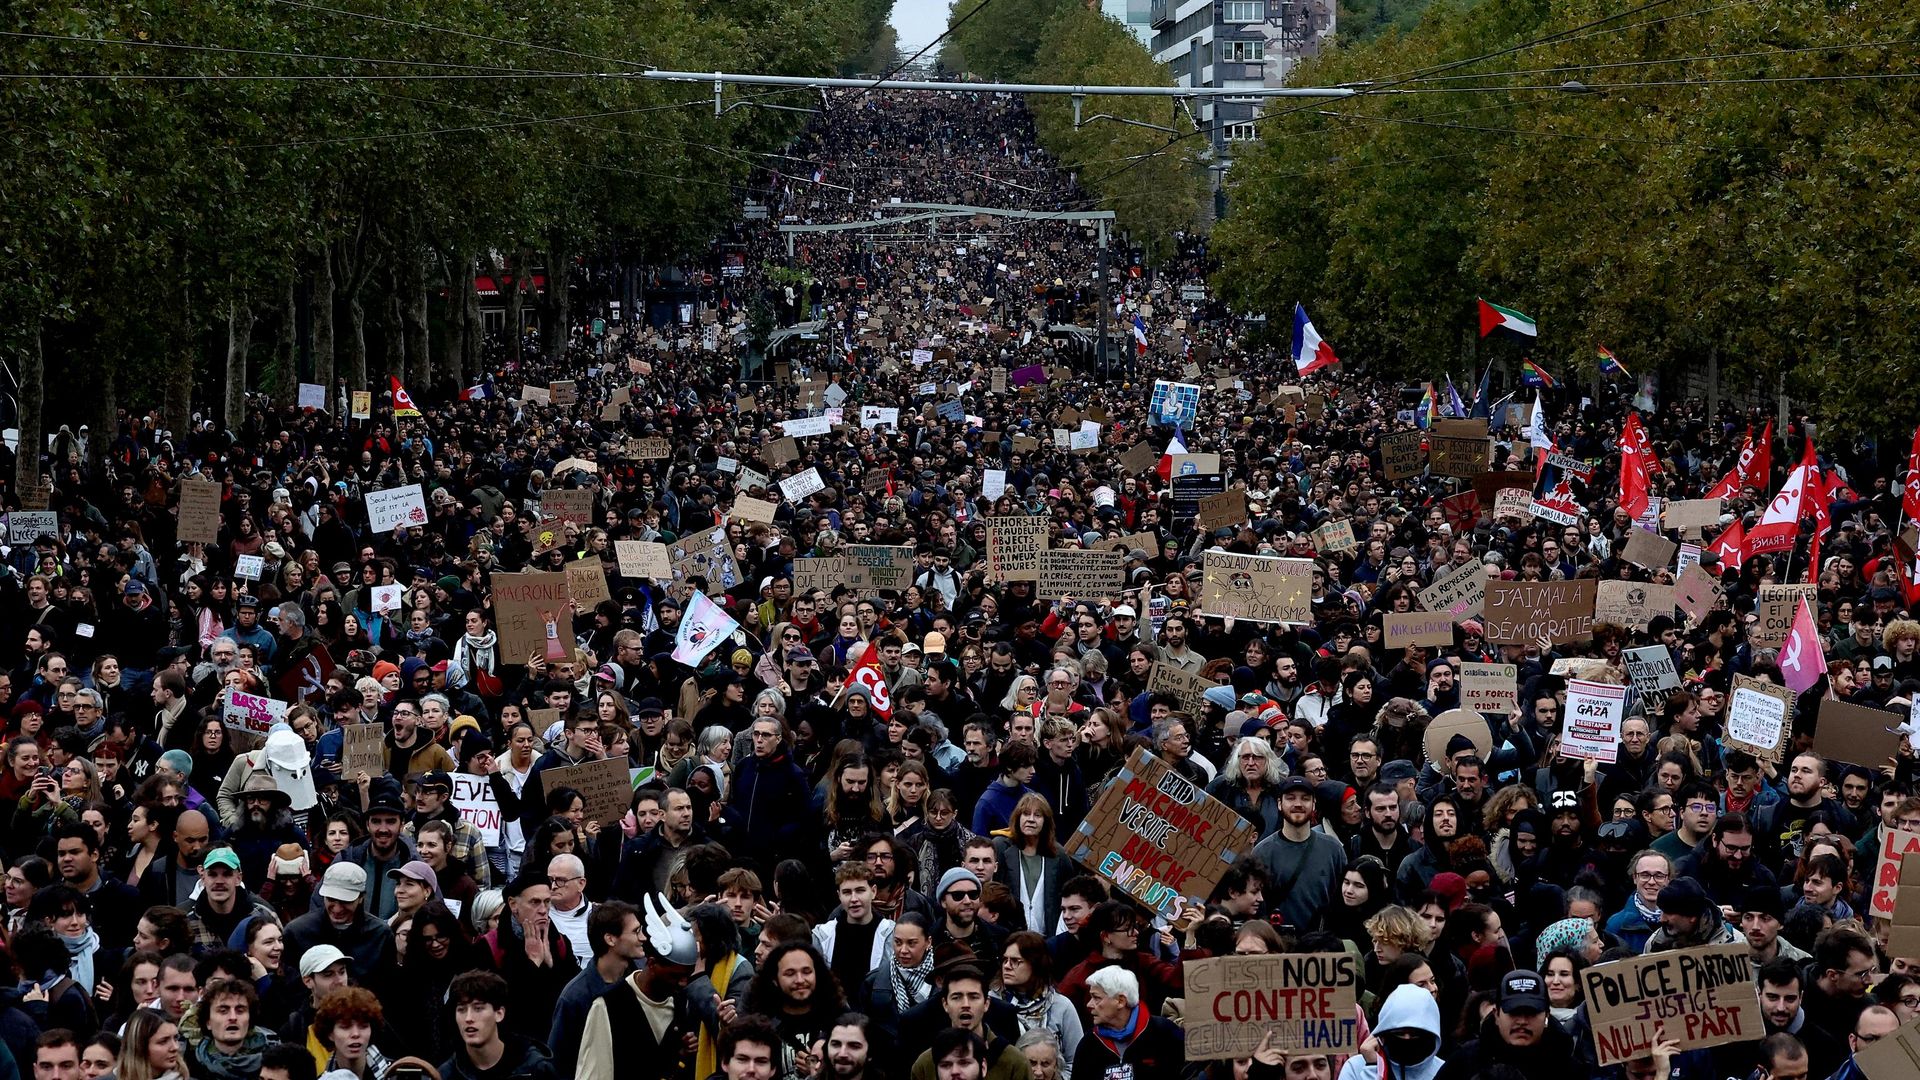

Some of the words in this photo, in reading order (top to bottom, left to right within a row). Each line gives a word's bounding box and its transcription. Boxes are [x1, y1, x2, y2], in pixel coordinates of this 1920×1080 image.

[632, 449, 668, 458] METHOD
[1498, 489, 1530, 497] MACRON
[1530, 504, 1541, 512] EST
[1541, 506, 1553, 517] DANS
[1554, 512, 1560, 520] LA
[1562, 514, 1576, 524] RUE
[992, 526, 1046, 536] FRAUDEURS
[992, 536, 1034, 545] ABJECTS
[848, 548, 893, 558] CONDAMNE
[896, 548, 913, 560] PAR
[993, 544, 1040, 554] CRAPULES
[858, 558, 894, 568] ESSENCE
[993, 552, 1036, 562] HAINEUX
[795, 560, 811, 572] IL
[994, 562, 1036, 571] ORDURES
[1254, 561, 1271, 573] SOUS
[869, 568, 906, 578] MINORITY
[797, 575, 816, 588] QUE
[822, 574, 839, 588] LES
[872, 576, 898, 586] RIPOST
[1465, 581, 1476, 592] LA
[496, 583, 566, 602] MACRONIE
[1425, 594, 1437, 603] LA
[1536, 586, 1567, 606] MAL
[1531, 608, 1551, 620] MA
[1770, 604, 1783, 616] ET
[1390, 626, 1408, 636] NIK
[1411, 626, 1423, 634] LES
[1488, 616, 1592, 640] DÉMOCRATIE
[1764, 632, 1778, 640] LES
[1624, 652, 1642, 662] LA
[1635, 676, 1660, 690] C'EST
[1467, 690, 1480, 698] LES
[1486, 690, 1514, 698] FORCES
[232, 692, 268, 712] BOSS
[249, 708, 273, 722] LADY
[1577, 704, 1608, 718] GAZA
[226, 714, 240, 725] SE
[567, 768, 583, 778] NOS
[590, 764, 607, 773] VIES
[1120, 835, 1197, 891] BOUCHE
[1098, 851, 1187, 922] ENFANTS
[1188, 960, 1279, 993] C'EST
[1283, 957, 1354, 987] NOUS
[1586, 960, 1677, 1013] POLICE
[1679, 954, 1751, 992] PARTOUT
[1213, 988, 1335, 1022] CONTRE
[1635, 989, 1719, 1020] JUSTICE
[1186, 1022, 1239, 1055] CEUX
[1303, 1019, 1356, 1048] HAUT
[1597, 1020, 1669, 1064] NULLE
[1684, 1007, 1741, 1041] PART
